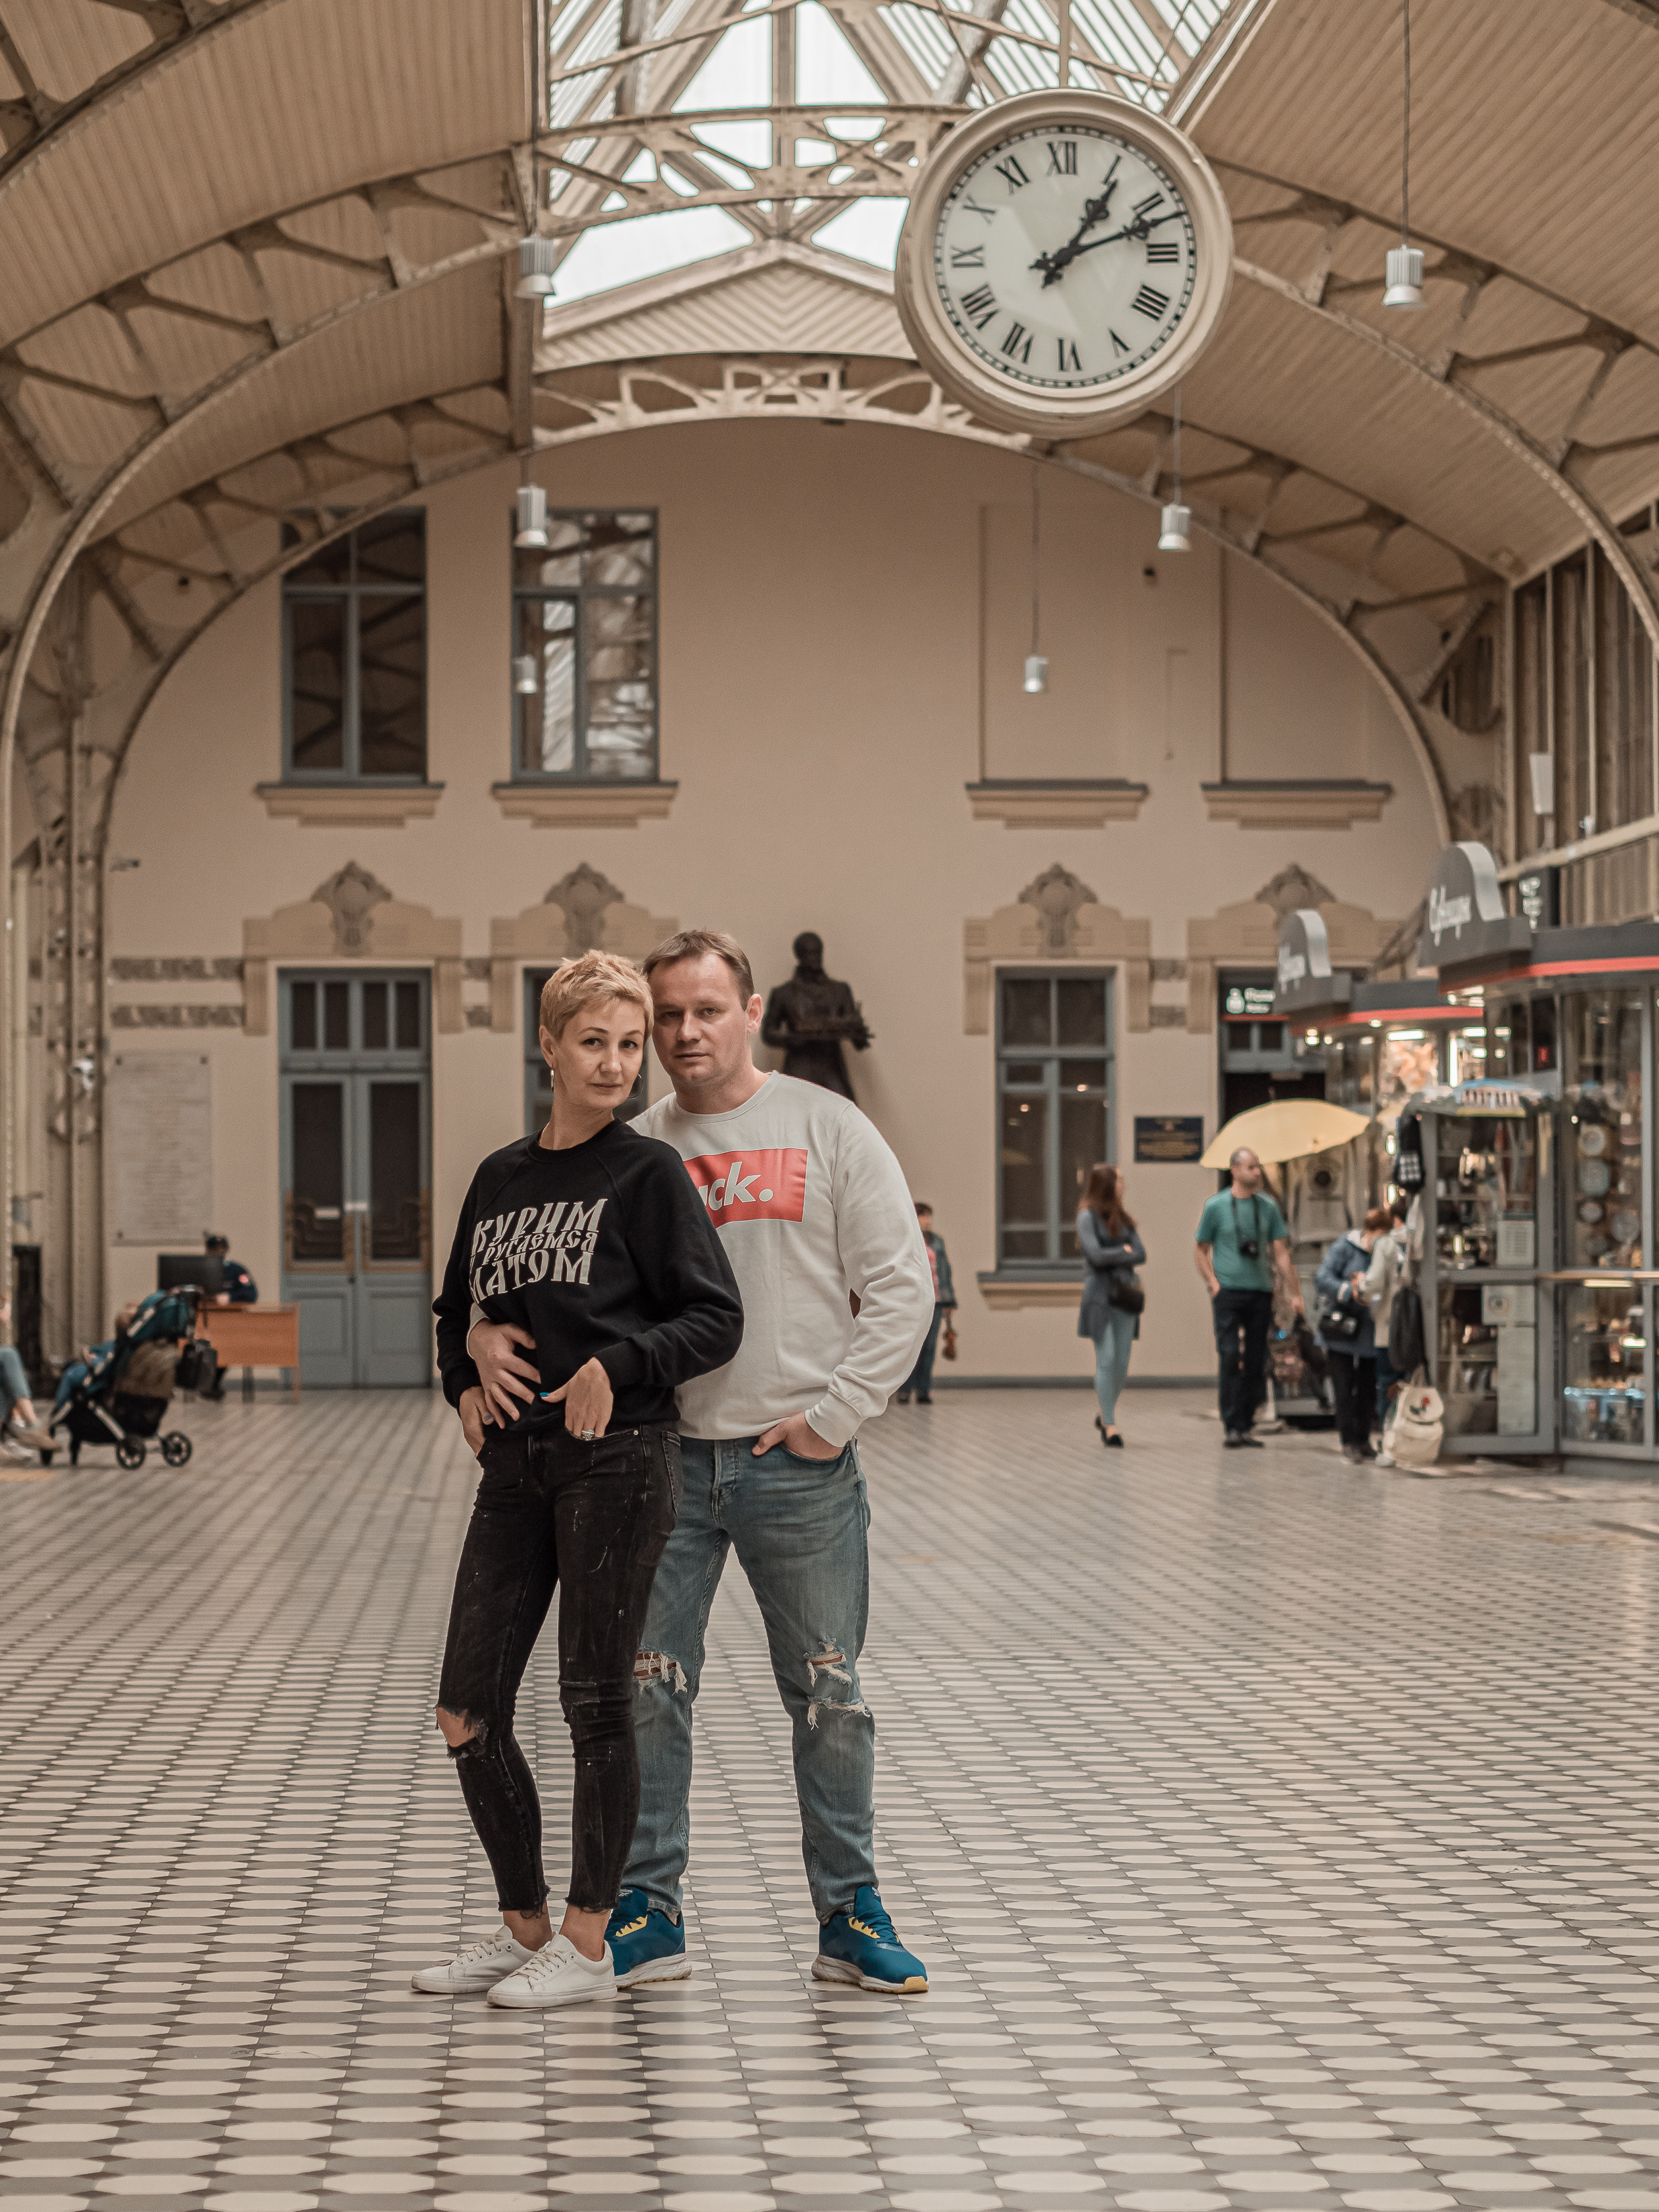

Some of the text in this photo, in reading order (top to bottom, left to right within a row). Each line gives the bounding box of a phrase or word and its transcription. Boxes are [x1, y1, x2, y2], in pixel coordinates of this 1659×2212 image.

[995, 155, 1031, 194] XI
[1047, 141, 1077, 175] XII
[963, 194, 995, 224] X
[1132, 192, 1165, 215] II
[950, 245, 985, 268] IX
[1146, 243, 1179, 263] III
[961, 285, 999, 330] VIII
[1131, 285, 1170, 321] IIII
[1001, 322, 1034, 363] VII
[1058, 339, 1082, 371] VI
[1109, 328, 1131, 357] V
[471, 1199, 608, 1257] КУРИМ
[482, 1231, 598, 1266] РУГАЕМСЯ
